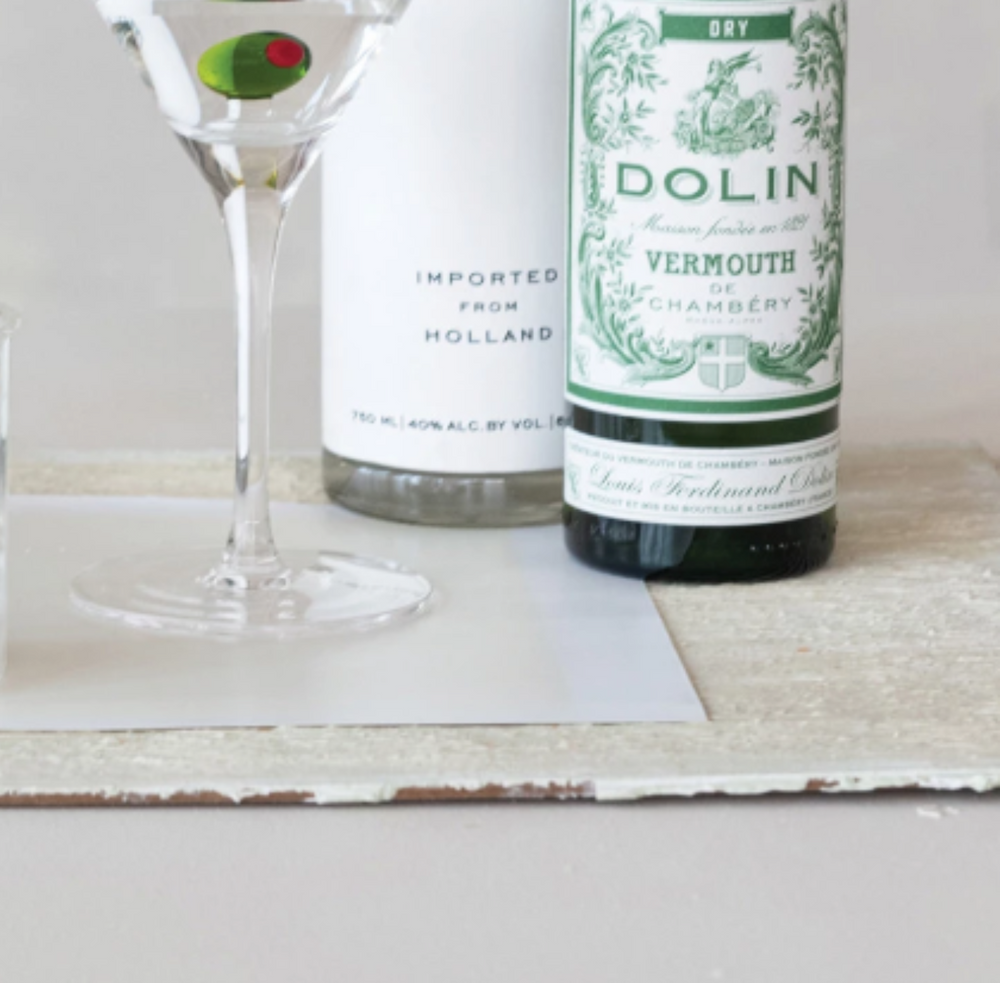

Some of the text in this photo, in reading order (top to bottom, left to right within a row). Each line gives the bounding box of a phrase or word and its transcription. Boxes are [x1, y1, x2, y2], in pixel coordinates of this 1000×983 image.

[709, 19, 749, 39] DRY
[615, 160, 818, 202] DOLIN
[646, 248, 797, 276] VERMOUTH
[416, 267, 559, 286] IMPORTED
[709, 282, 737, 295] DE
[459, 301, 519, 313] FROM
[649, 295, 794, 314] CHAMBÉRY
[425, 326, 554, 344] HOLLAND
[352, 410, 377, 424] 750
[380, 414, 398, 428] ML
[408, 419, 444, 432] 40%
